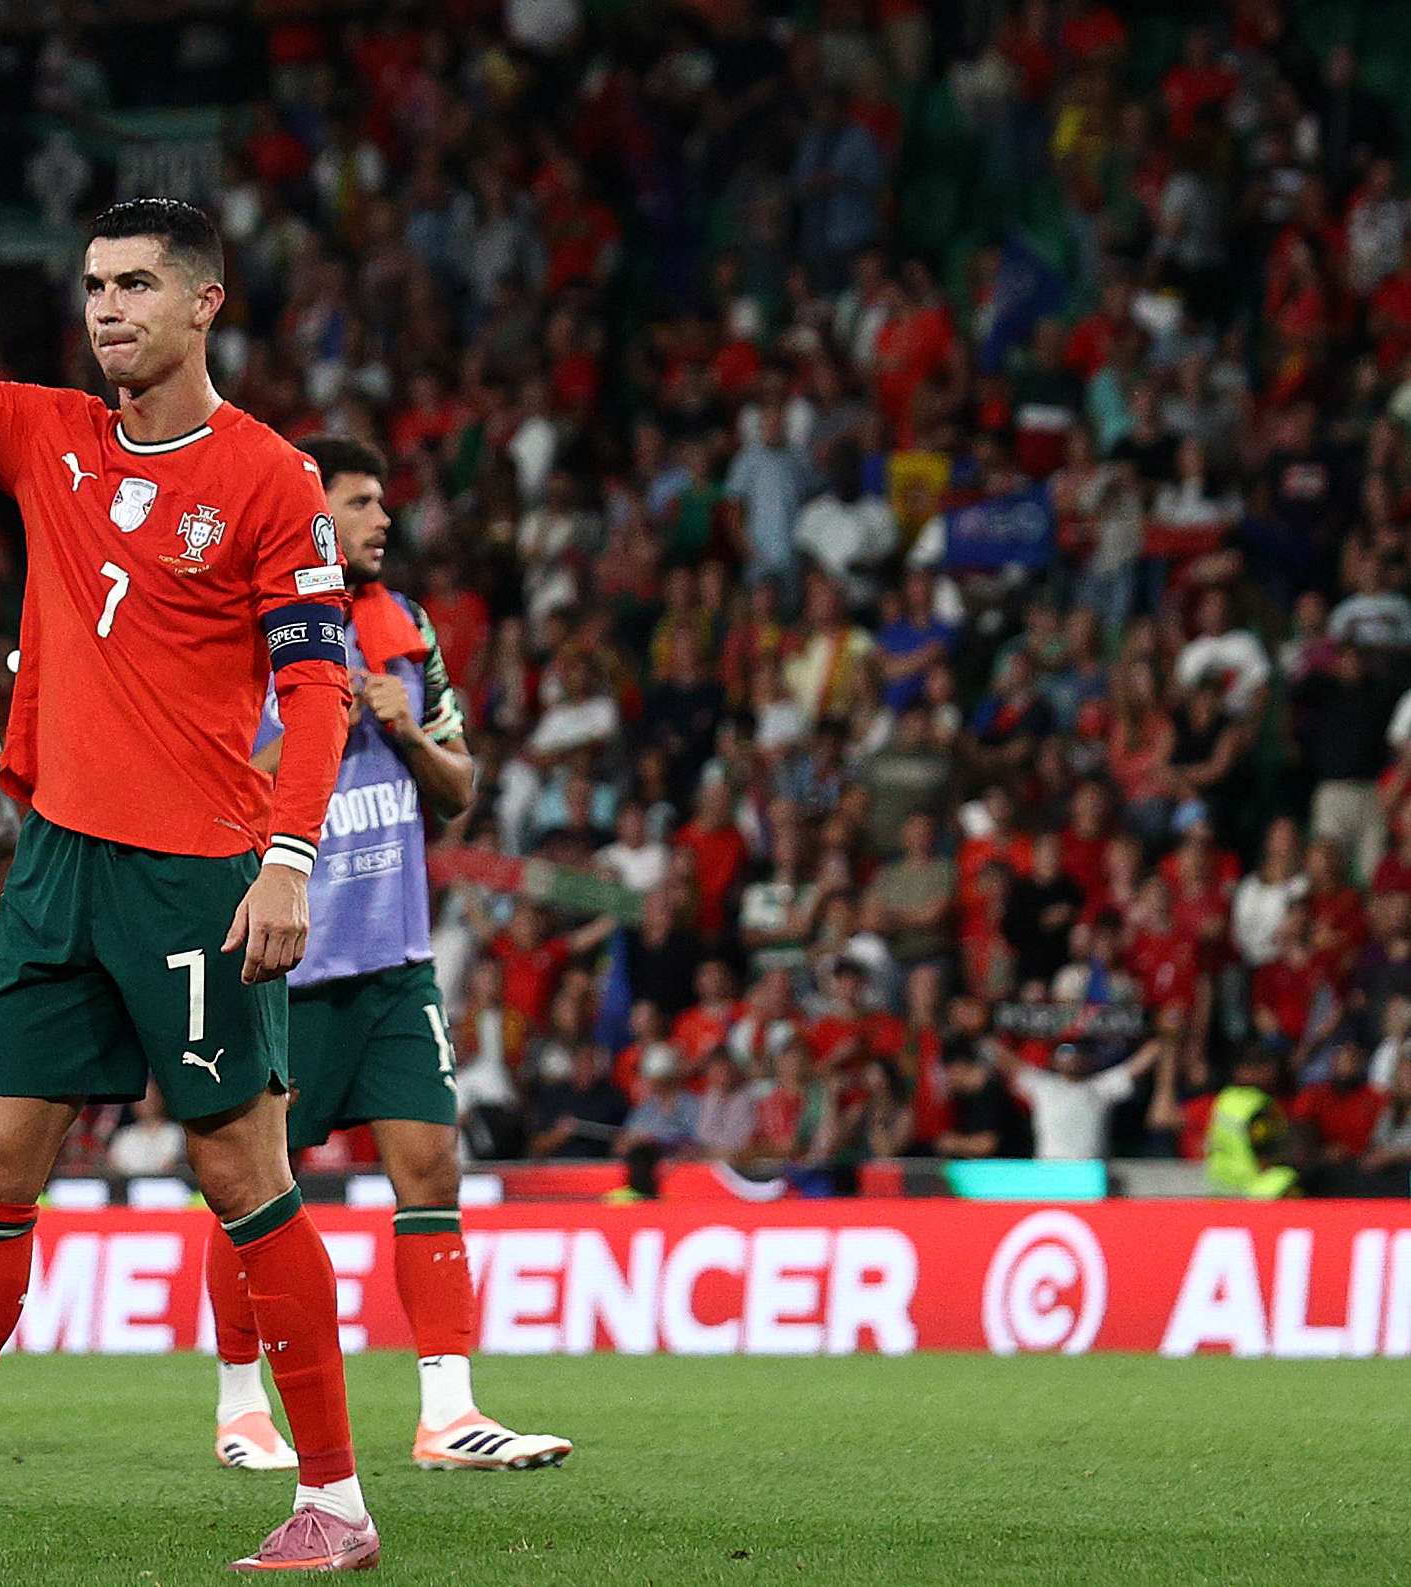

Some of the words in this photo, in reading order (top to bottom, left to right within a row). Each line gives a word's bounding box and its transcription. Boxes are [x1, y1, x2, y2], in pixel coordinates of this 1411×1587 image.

[97, 560, 130, 639] 7
[165, 948, 205, 1042] 7
[422, 1004, 458, 1073] 1
[1158, 1226, 1411, 1357] ALI
